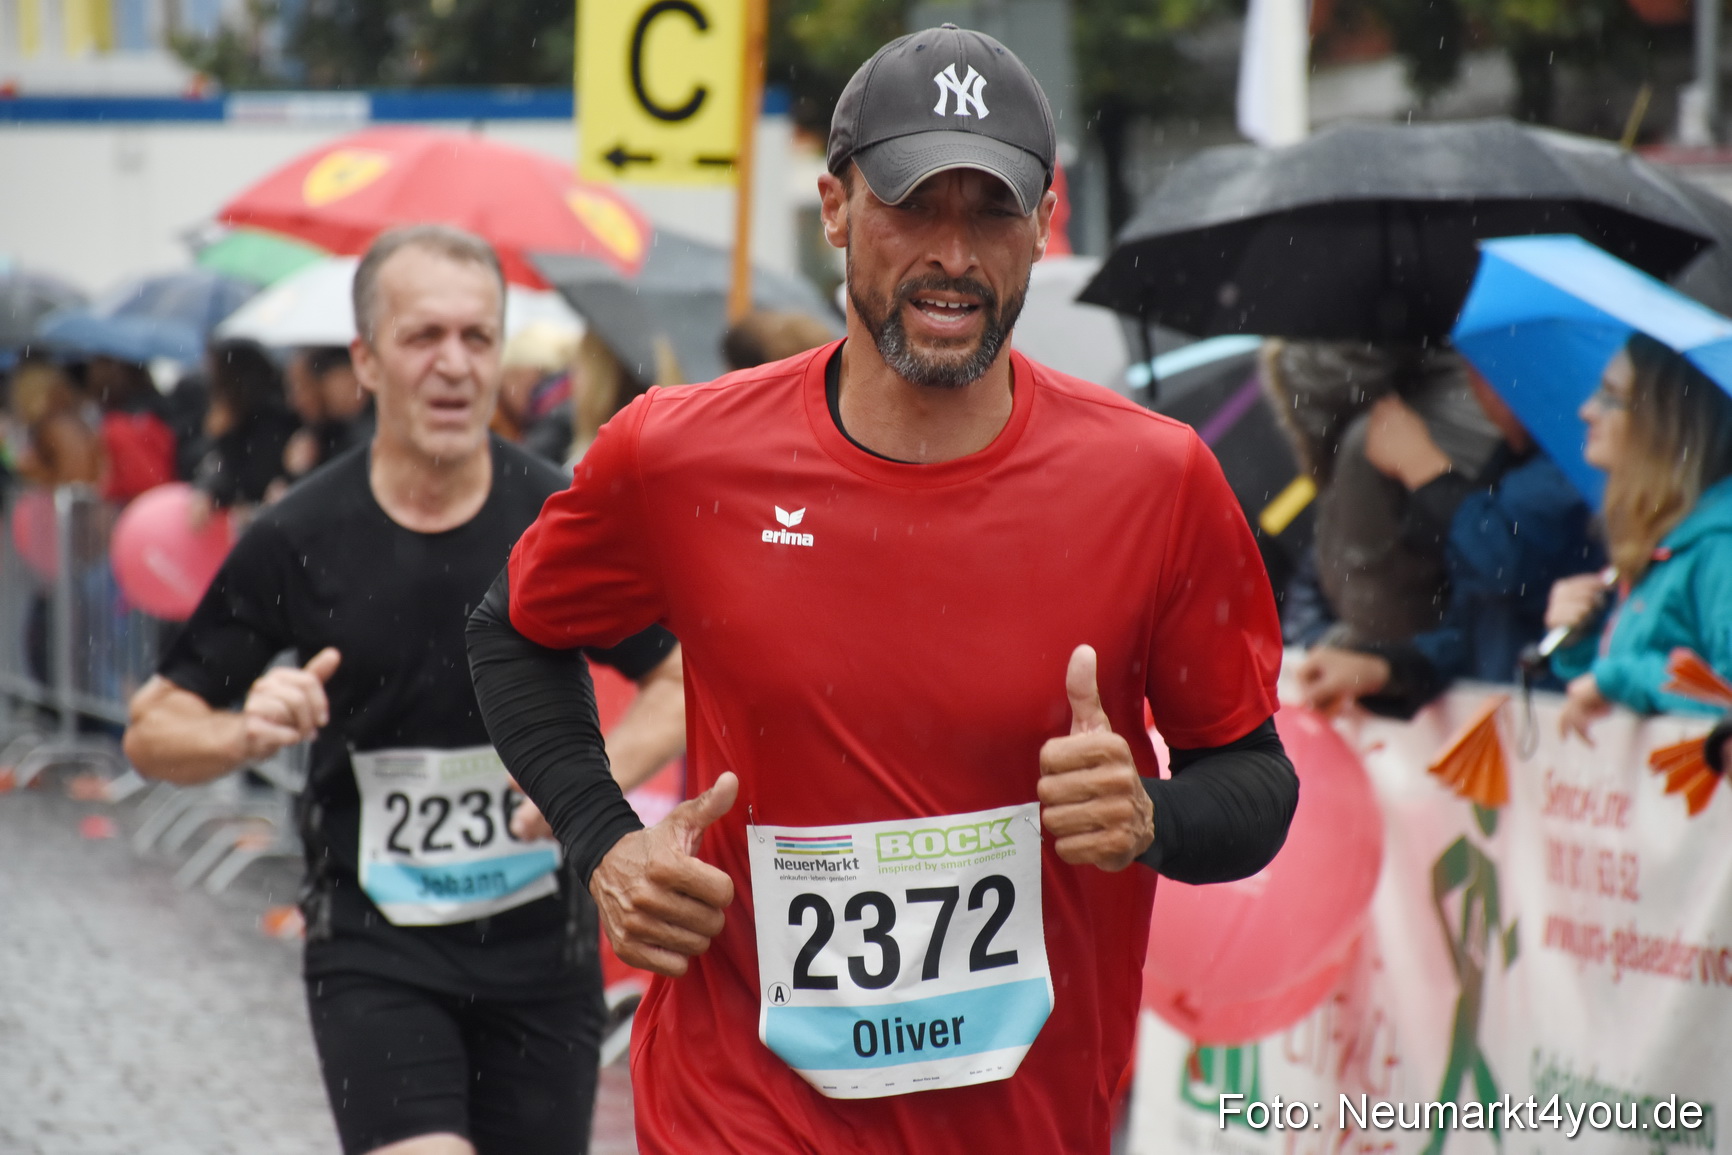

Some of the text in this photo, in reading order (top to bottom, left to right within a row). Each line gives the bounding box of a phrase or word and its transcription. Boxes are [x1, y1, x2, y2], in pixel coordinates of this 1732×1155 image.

[630, 0, 709, 122] C
[761, 528, 814, 547] erima
[875, 817, 1015, 862] BOCK
[773, 857, 860, 872] NeuerMarkt
[878, 848, 1017, 874] inspired by smart concepts
[788, 874, 1019, 991] 2372
[774, 985, 785, 1003] A
[852, 1015, 965, 1059] Oliver
